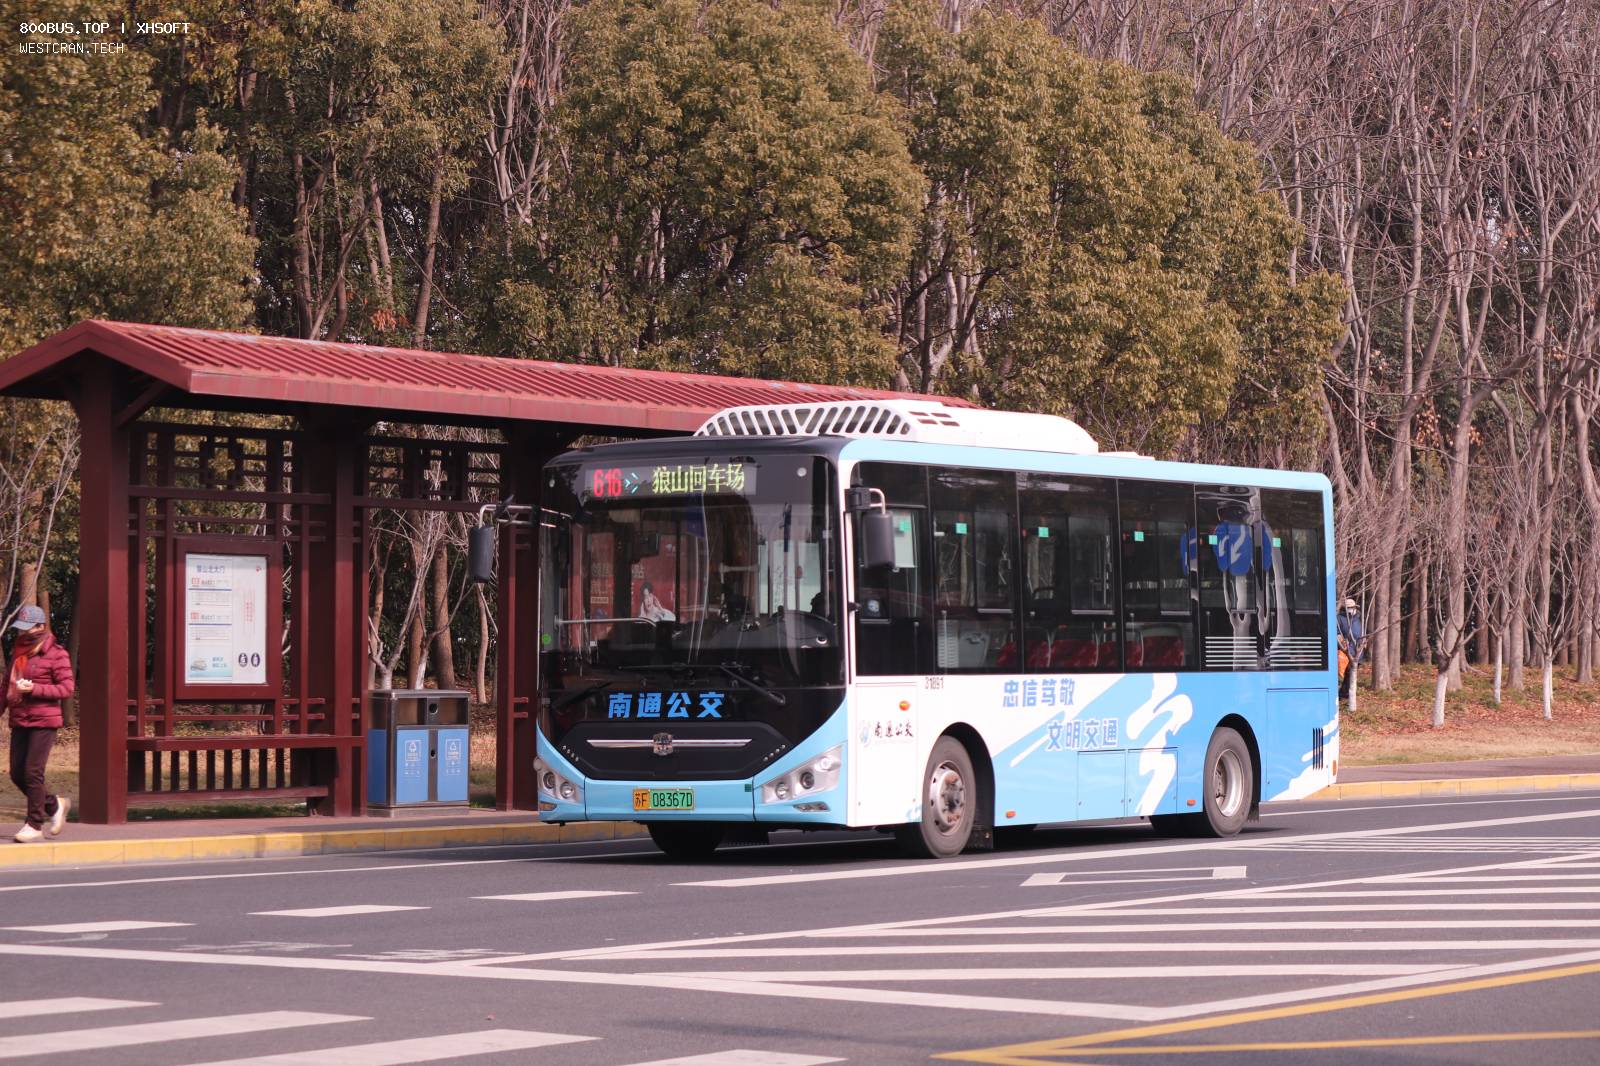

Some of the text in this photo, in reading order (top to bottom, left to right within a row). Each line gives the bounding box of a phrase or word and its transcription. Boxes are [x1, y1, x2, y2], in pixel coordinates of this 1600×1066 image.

[592, 468, 623, 497] 616
[652, 463, 746, 495] 狼山回车场
[608, 692, 724, 718] 南通公交
[1002, 679, 1075, 707] 忠信笃敬
[1047, 720, 1118, 749] 文明交通
[652, 791, 693, 808] 08367D
